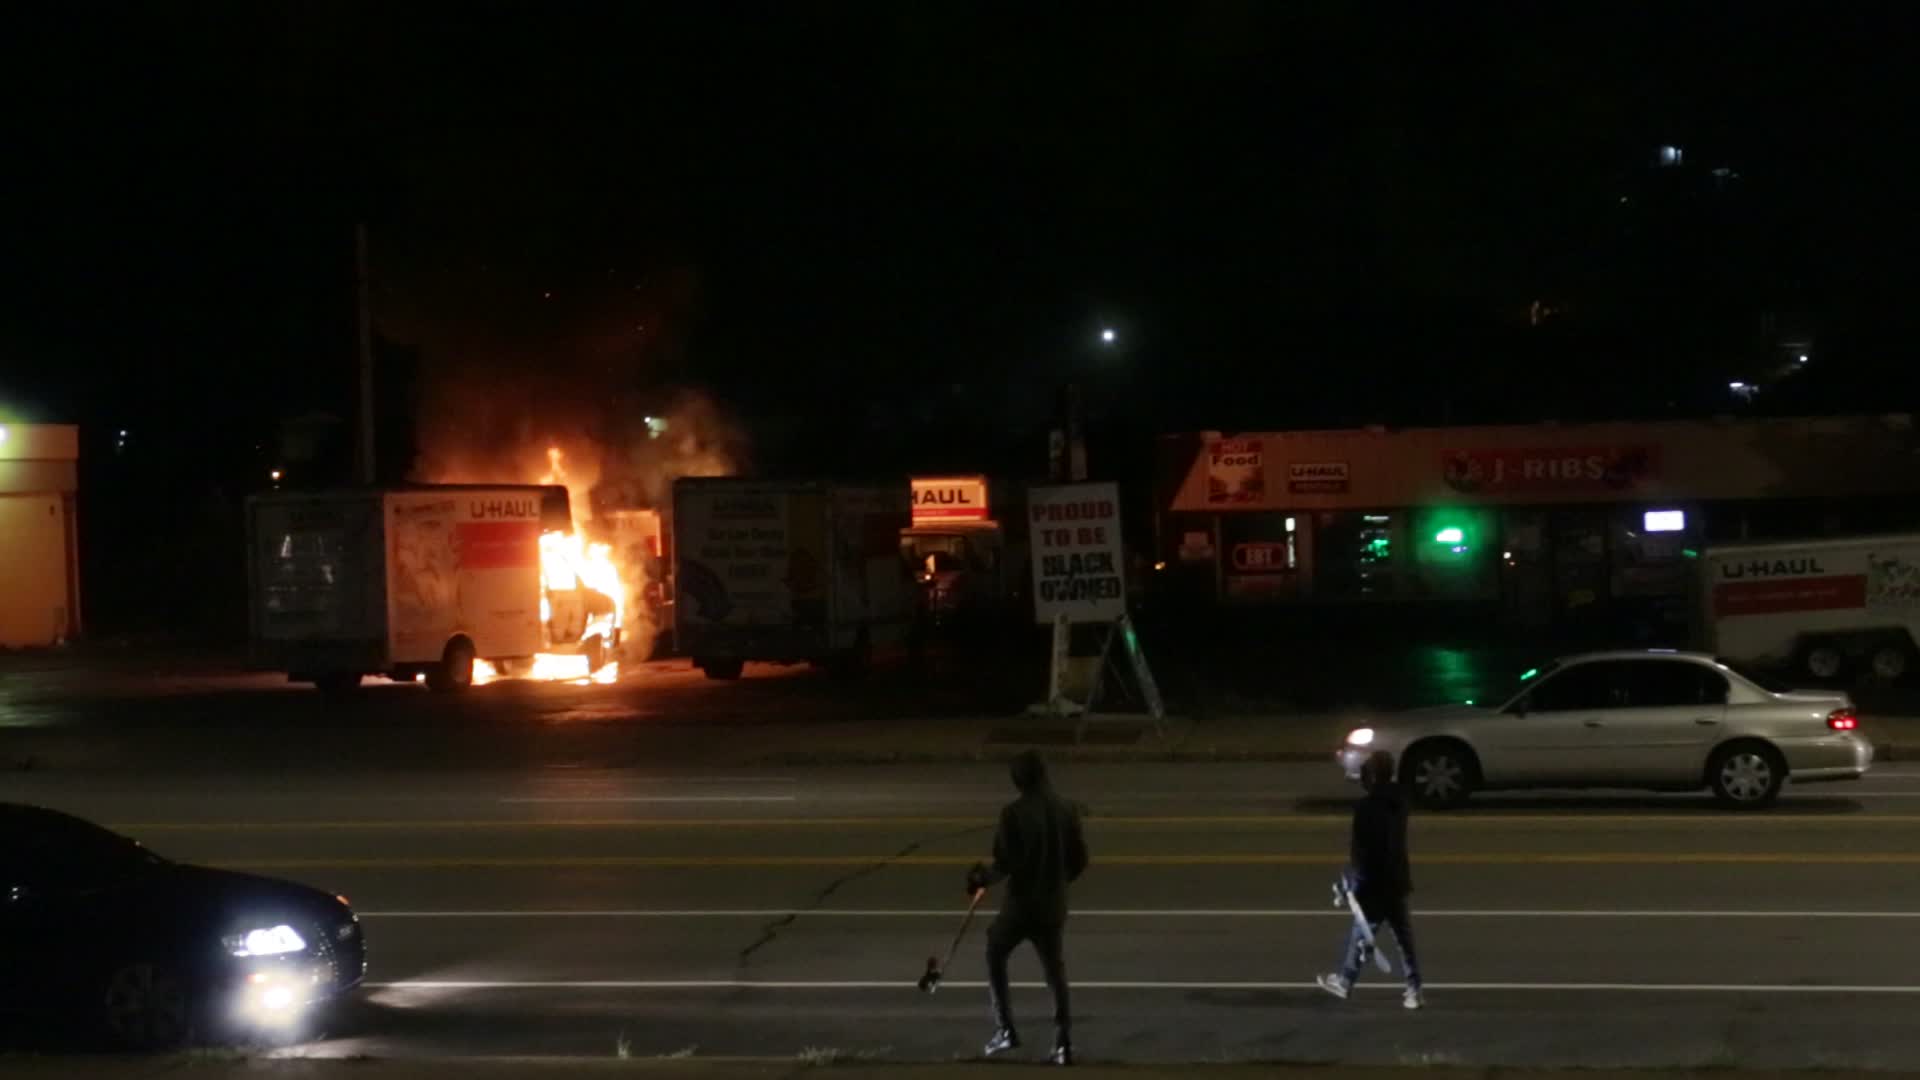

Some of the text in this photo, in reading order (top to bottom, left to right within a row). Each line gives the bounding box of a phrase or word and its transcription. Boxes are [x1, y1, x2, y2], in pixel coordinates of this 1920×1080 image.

[1212, 455, 1259, 466] Food
[1031, 501, 1113, 522] PROUD
[1040, 527, 1106, 547] TO BE
[1041, 551, 1115, 576] BLACK
[1722, 558, 1825, 578] U-HAUL
[1039, 577, 1120, 602] OWNED
